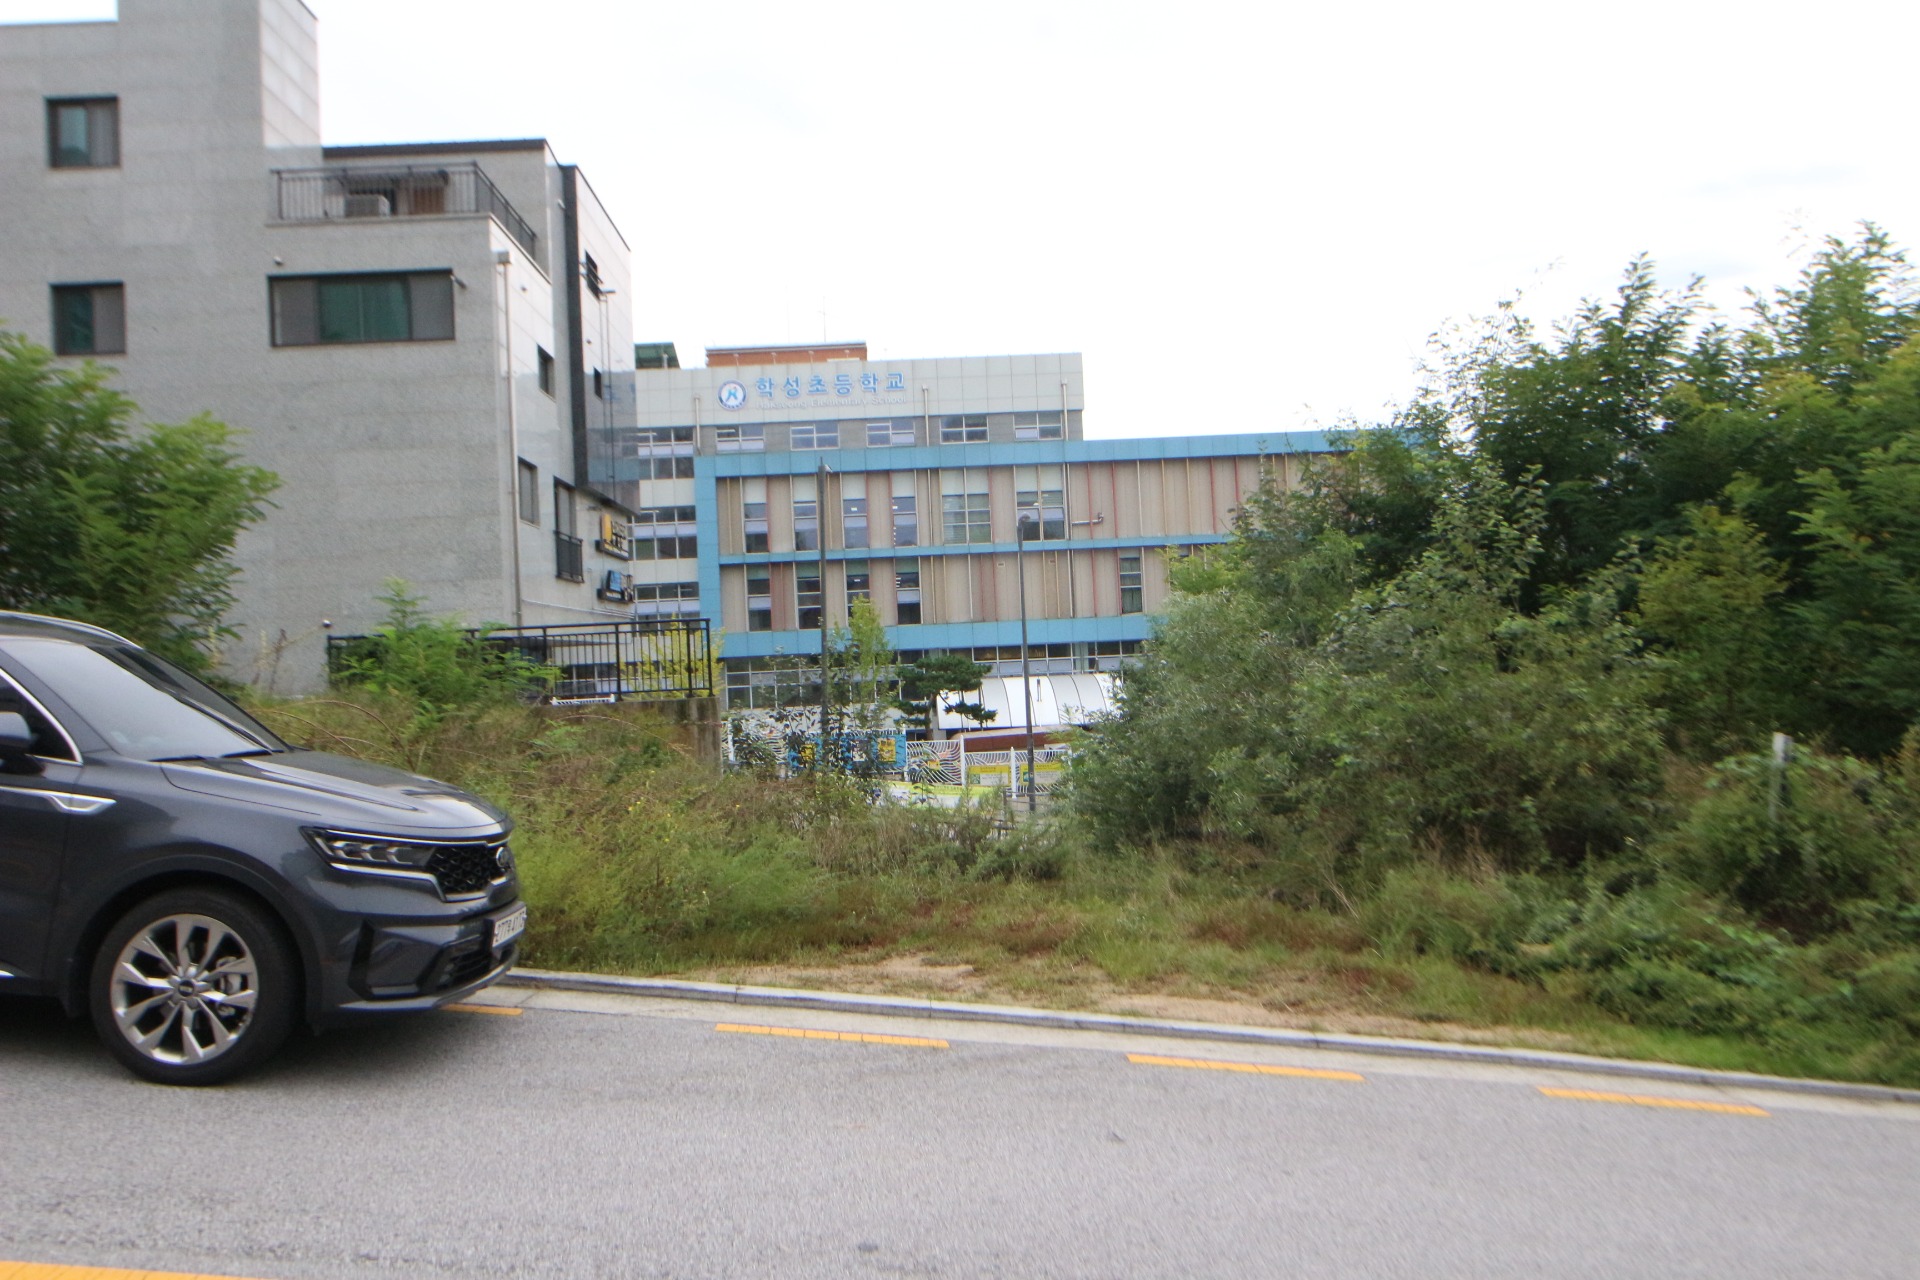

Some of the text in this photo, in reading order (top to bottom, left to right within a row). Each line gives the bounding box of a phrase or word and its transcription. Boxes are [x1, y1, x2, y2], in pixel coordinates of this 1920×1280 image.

[756, 373, 905, 398] 학성초등학교
[811, 397, 867, 407] Elementary
[871, 395, 906, 405] School
